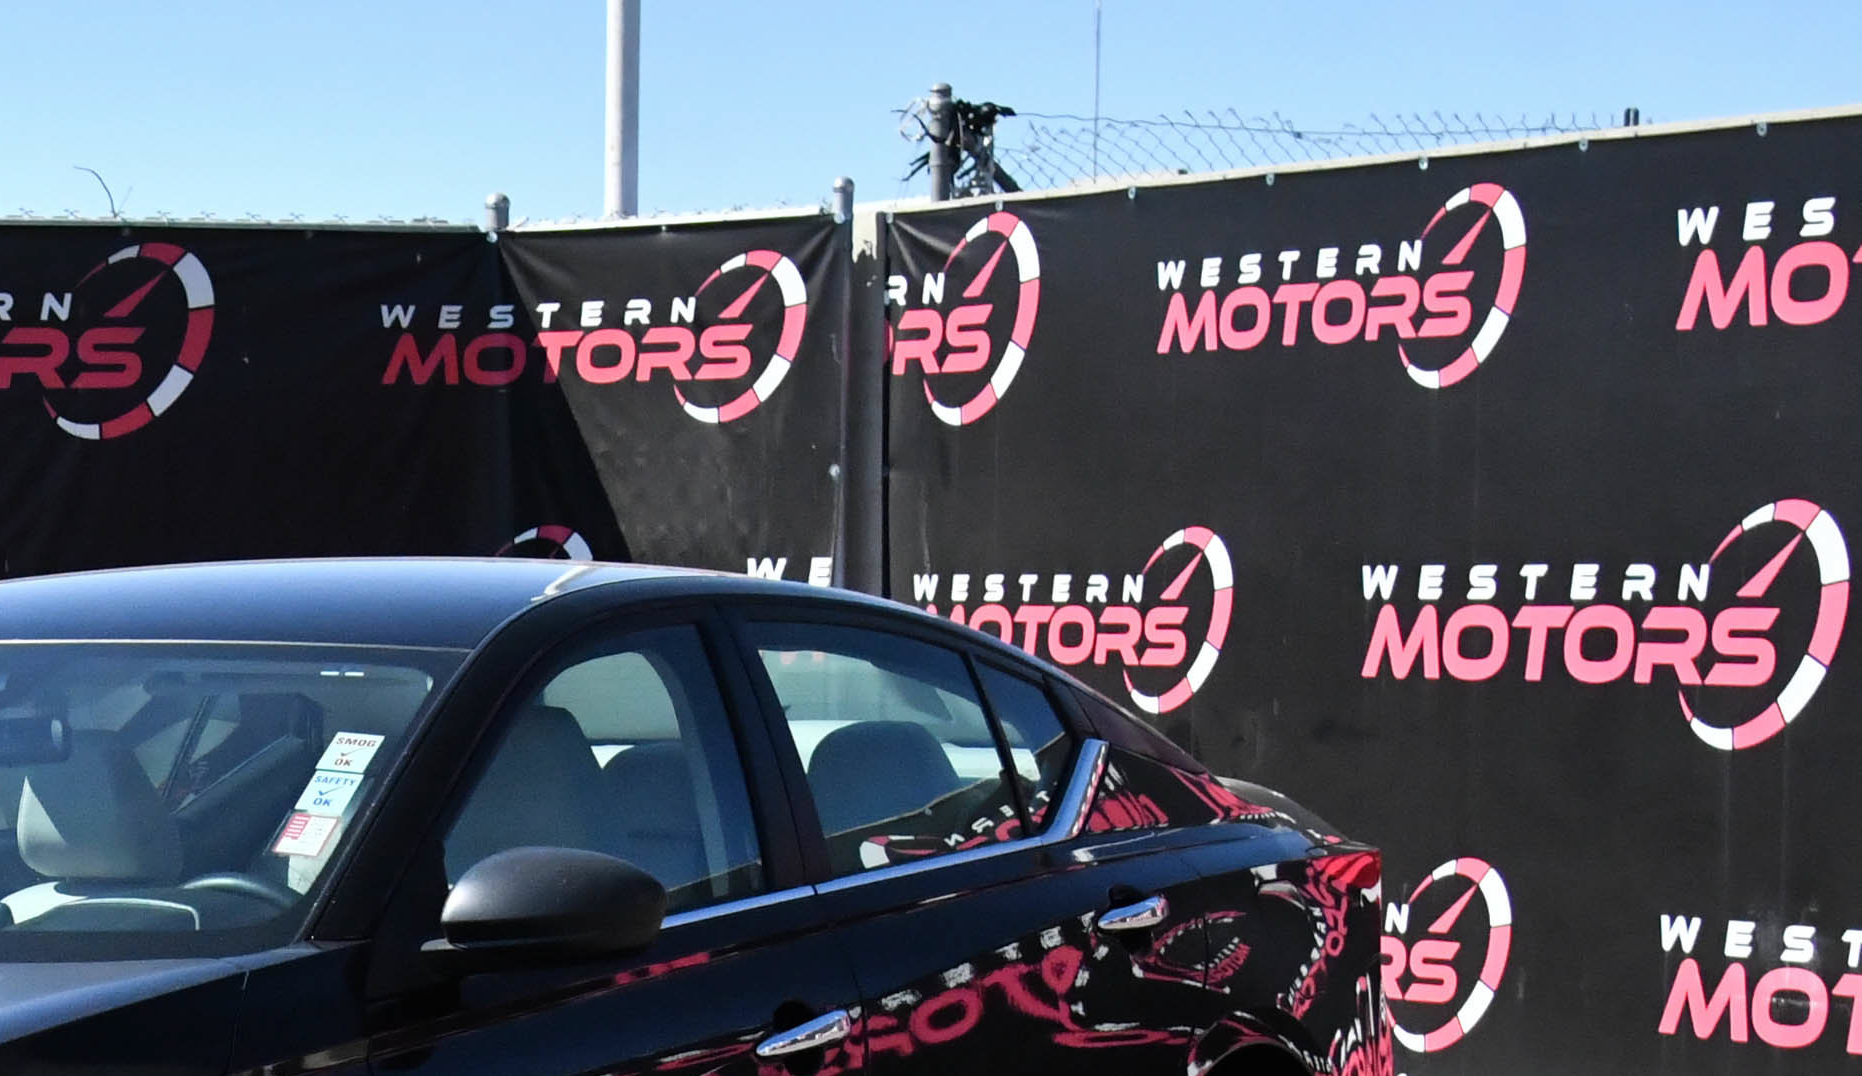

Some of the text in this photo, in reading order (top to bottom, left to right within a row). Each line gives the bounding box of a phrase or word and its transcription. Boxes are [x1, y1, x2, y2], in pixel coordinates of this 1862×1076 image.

[1157, 240, 1423, 290] WESTERN
[1677, 241, 1862, 331] MO
[380, 296, 696, 329] WESTERN
[1157, 270, 1474, 354] MOTORS
[381, 323, 753, 385] MOTORS
[885, 304, 993, 376] RS
[913, 574, 1144, 603] WESTERN
[1362, 564, 1710, 601] WESTERN
[928, 603, 1189, 667] OTORS
[1361, 603, 1781, 687] MOTORS
[334, 758, 353, 767] OK
[336, 737, 377, 748] SMOG
[313, 797, 333, 807] OK
